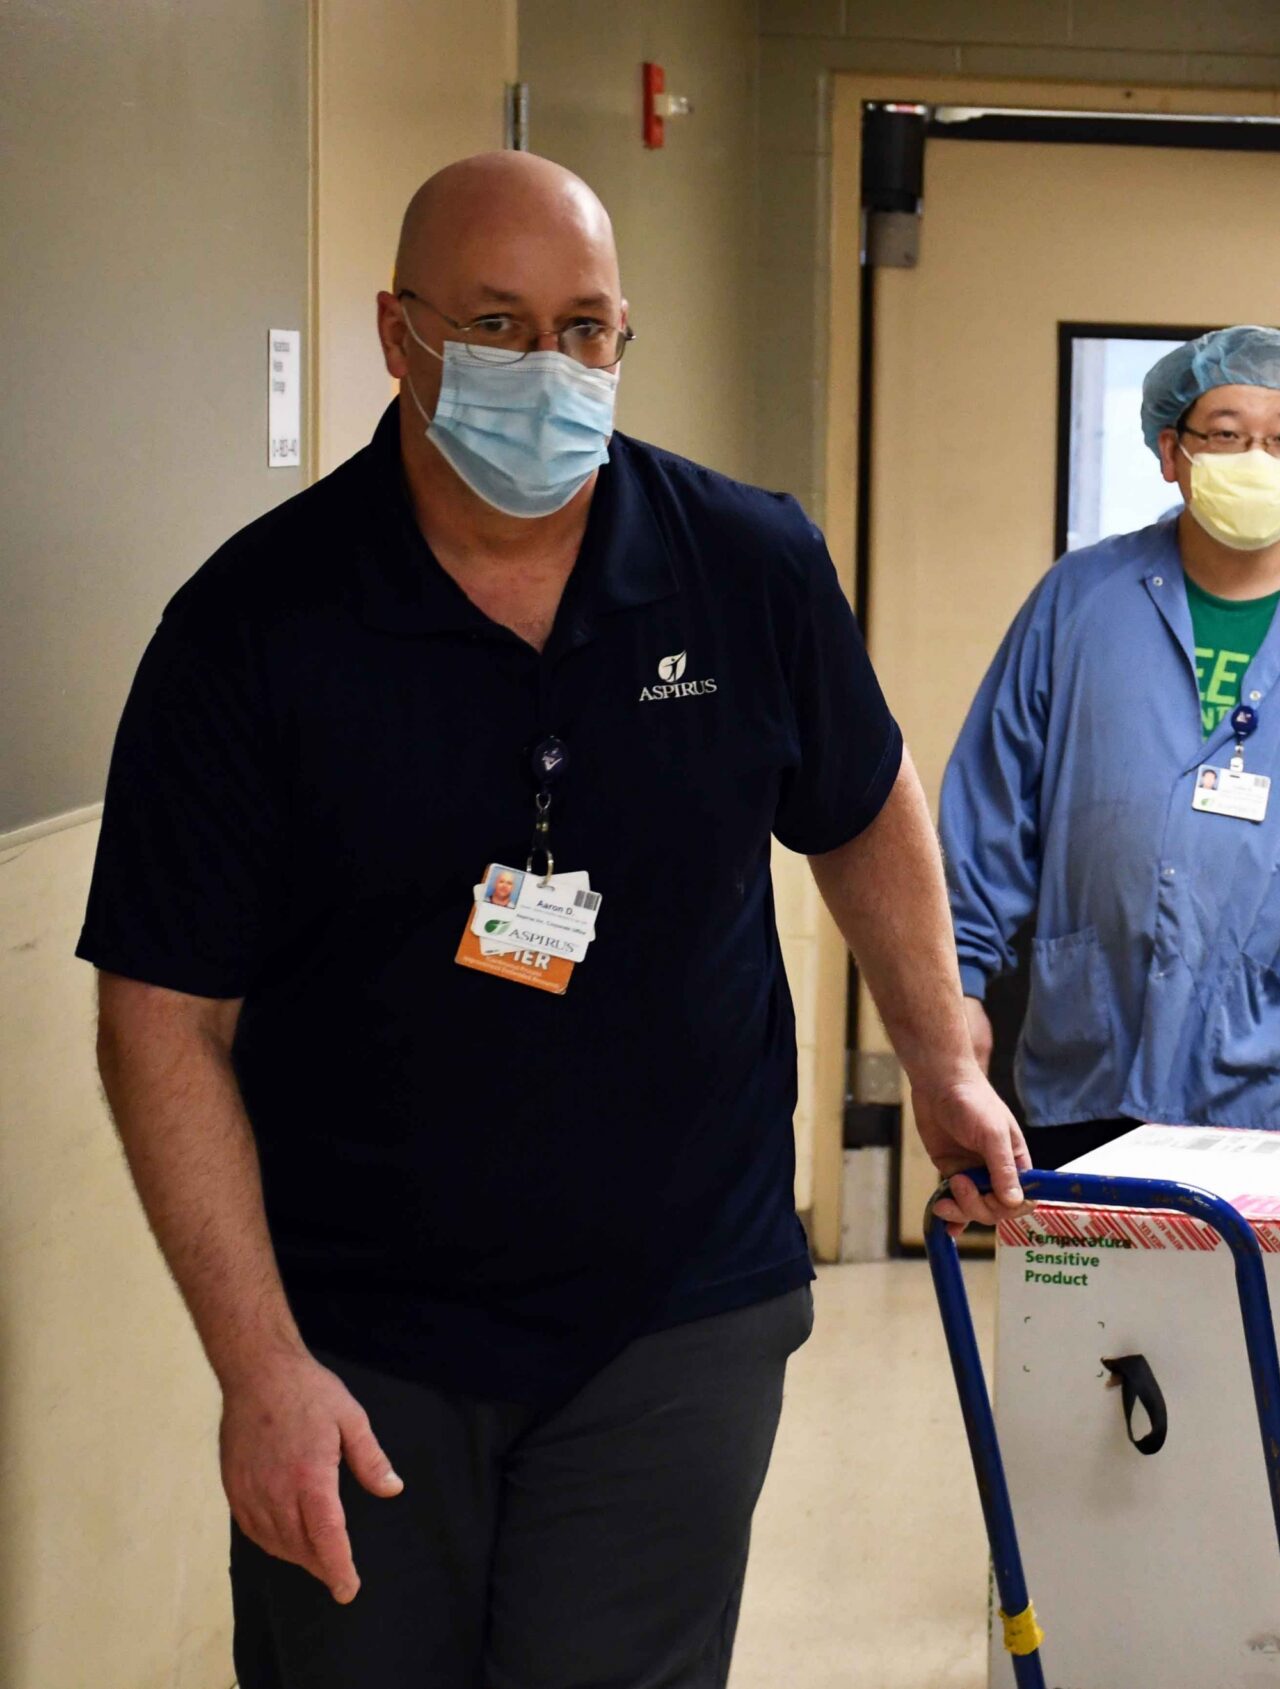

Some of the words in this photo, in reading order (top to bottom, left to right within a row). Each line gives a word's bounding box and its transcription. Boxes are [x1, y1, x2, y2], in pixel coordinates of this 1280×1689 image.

[639, 678, 718, 702] ASPIRUS
[536, 899, 564, 913] Aaron
[508, 928, 576, 953] ASPIRUS
[1027, 1230, 1132, 1249] Temperature
[1025, 1250, 1100, 1267] Sensitive
[1025, 1269, 1089, 1286] Product
